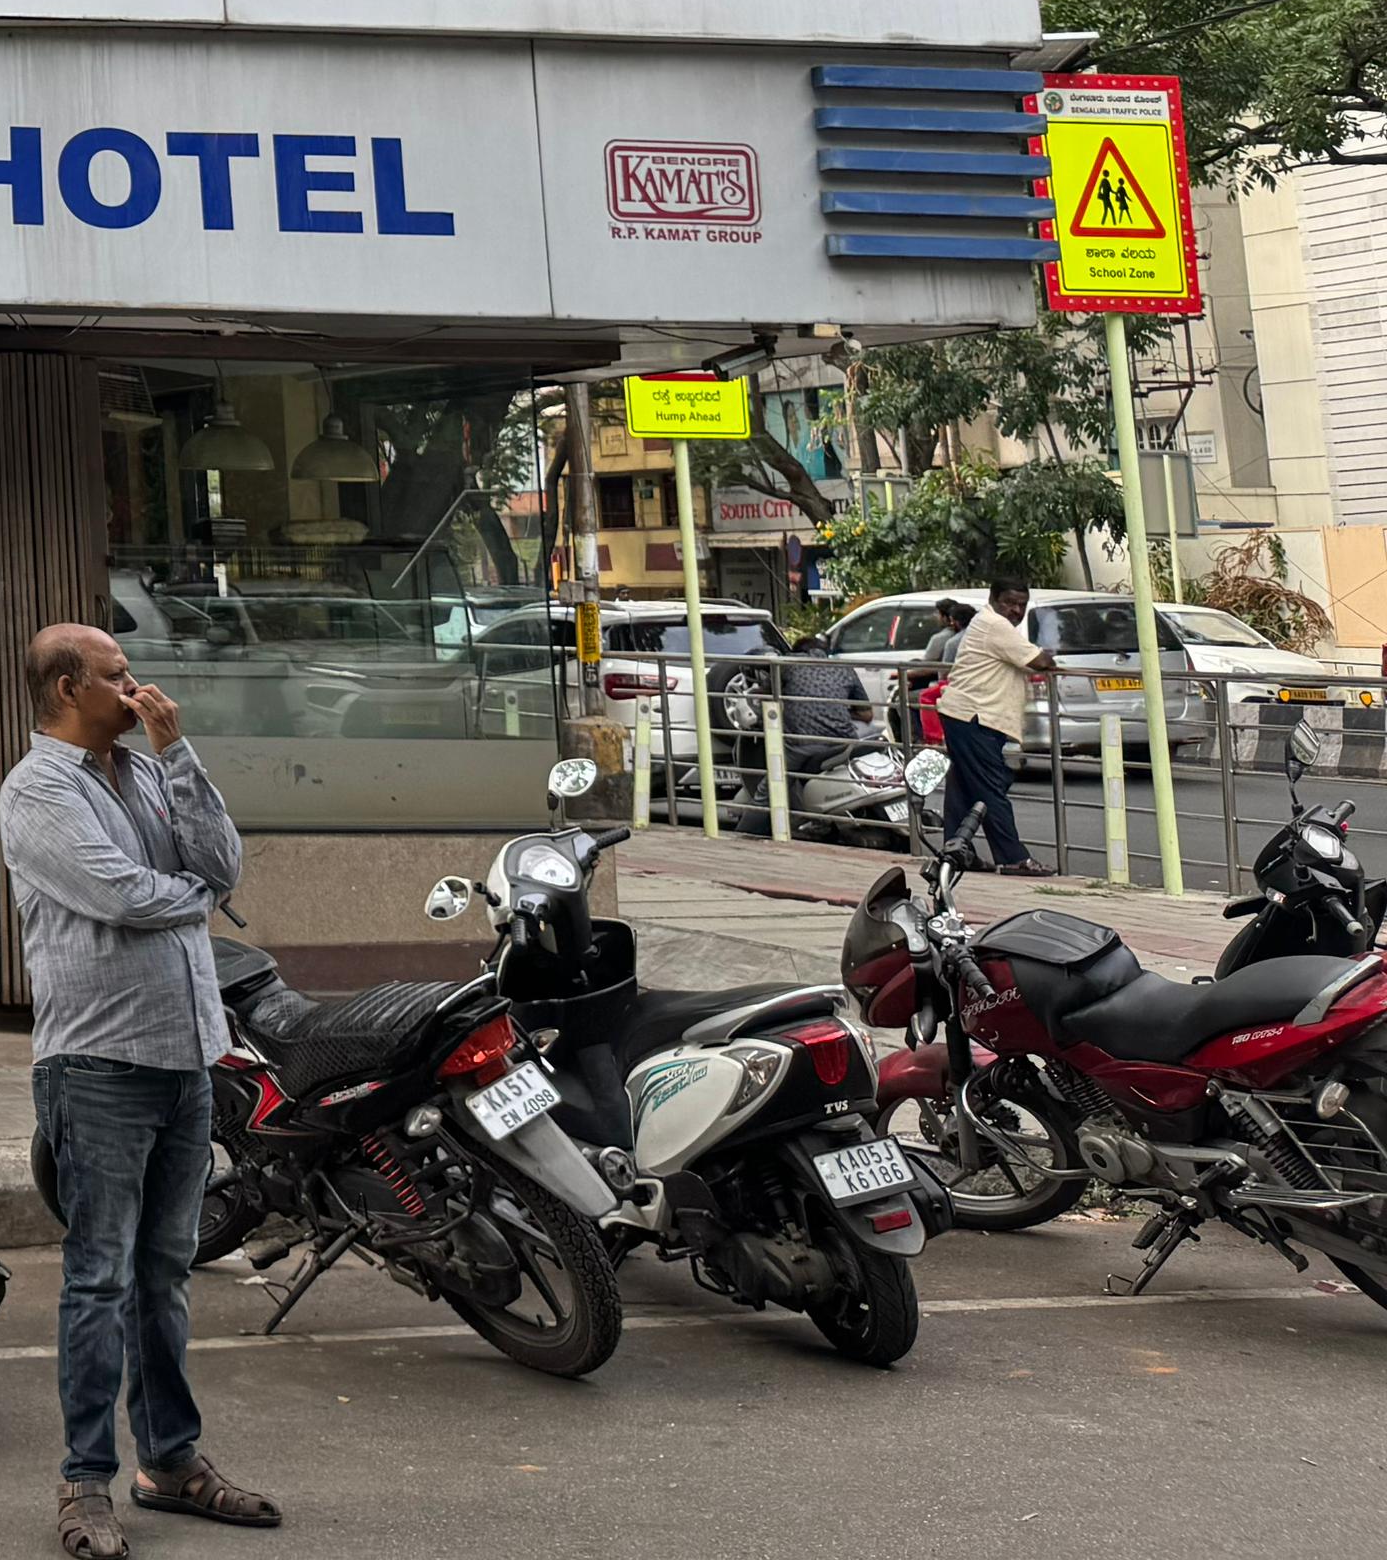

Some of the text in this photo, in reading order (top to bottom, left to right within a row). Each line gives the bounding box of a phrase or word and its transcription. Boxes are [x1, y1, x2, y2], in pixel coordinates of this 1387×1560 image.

[1139, 108, 1162, 116] POLICE
[651, 155, 740, 167] BENGRE
[617, 154, 747, 207] KAMAT'S
[611, 226, 762, 243] R.P. KAMAT GROUP
[1085, 246, 1156, 259] ಶಾಲಾ ವಲಯ
[1089, 266, 1156, 278] School Zone
[656, 410, 721, 423] Hump Ahead
[720, 503, 760, 520] SOUTH
[763, 499, 794, 520] CITY
[500, 1089, 555, 1129] EN 4098
[824, 1100, 849, 1114] TVS
[835, 1142, 894, 1174] KA05J
[844, 1162, 905, 1193] K6186
